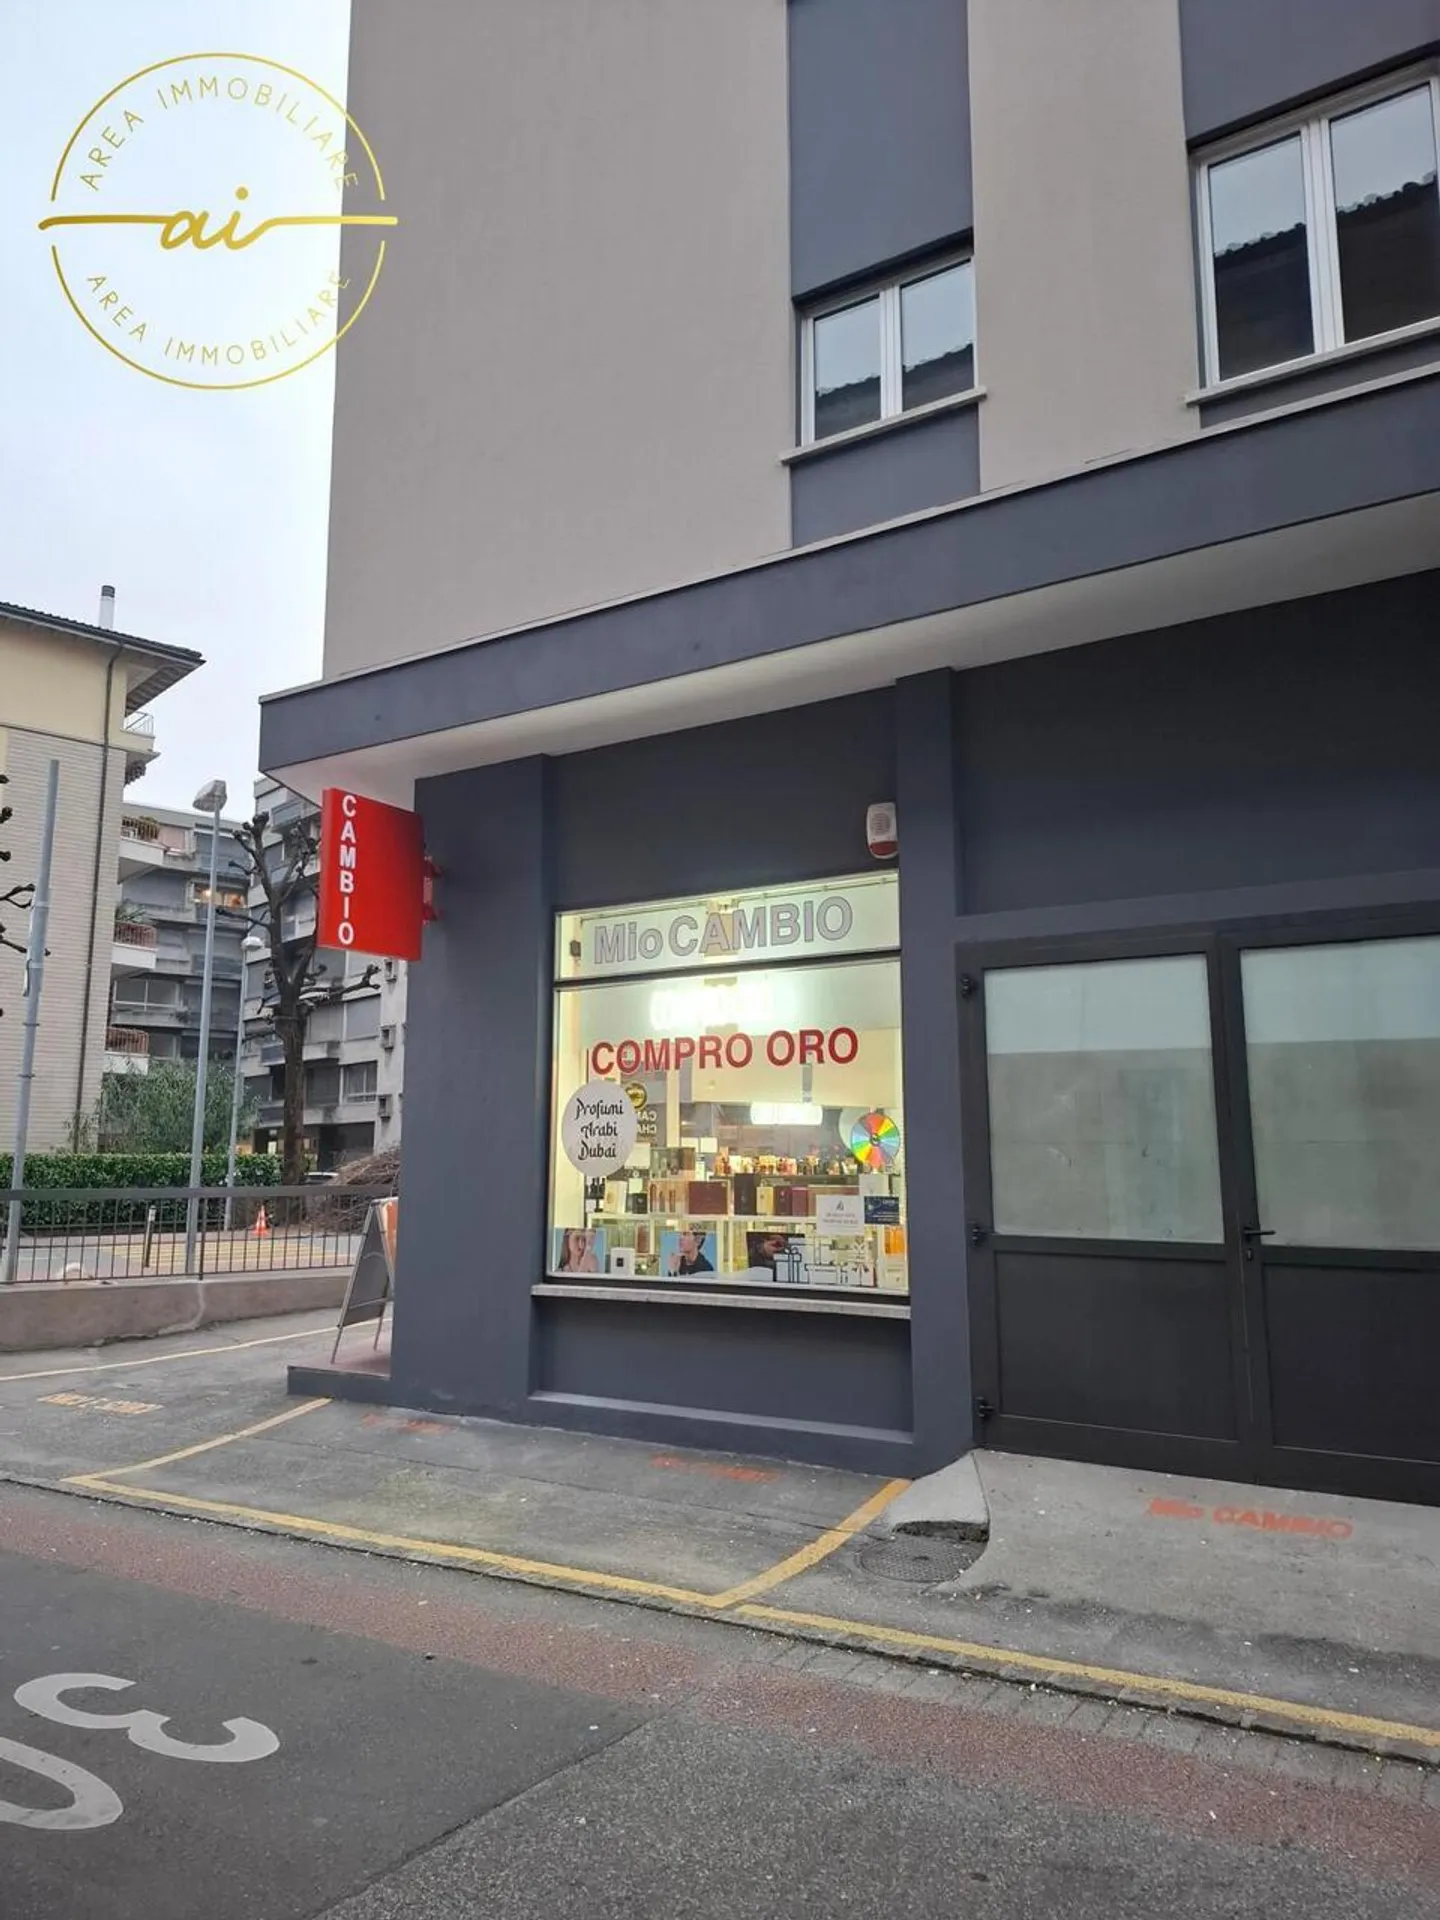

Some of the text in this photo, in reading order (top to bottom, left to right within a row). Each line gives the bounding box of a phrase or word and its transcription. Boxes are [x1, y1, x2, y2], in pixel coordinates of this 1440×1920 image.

[338, 794, 357, 944] CAMBIO
[590, 1026, 860, 1076] COMPRO ORO
[575, 1098, 625, 1120] Profumi
[580, 1121, 618, 1139] Arabi
[577, 1140, 617, 1161] Dubai
